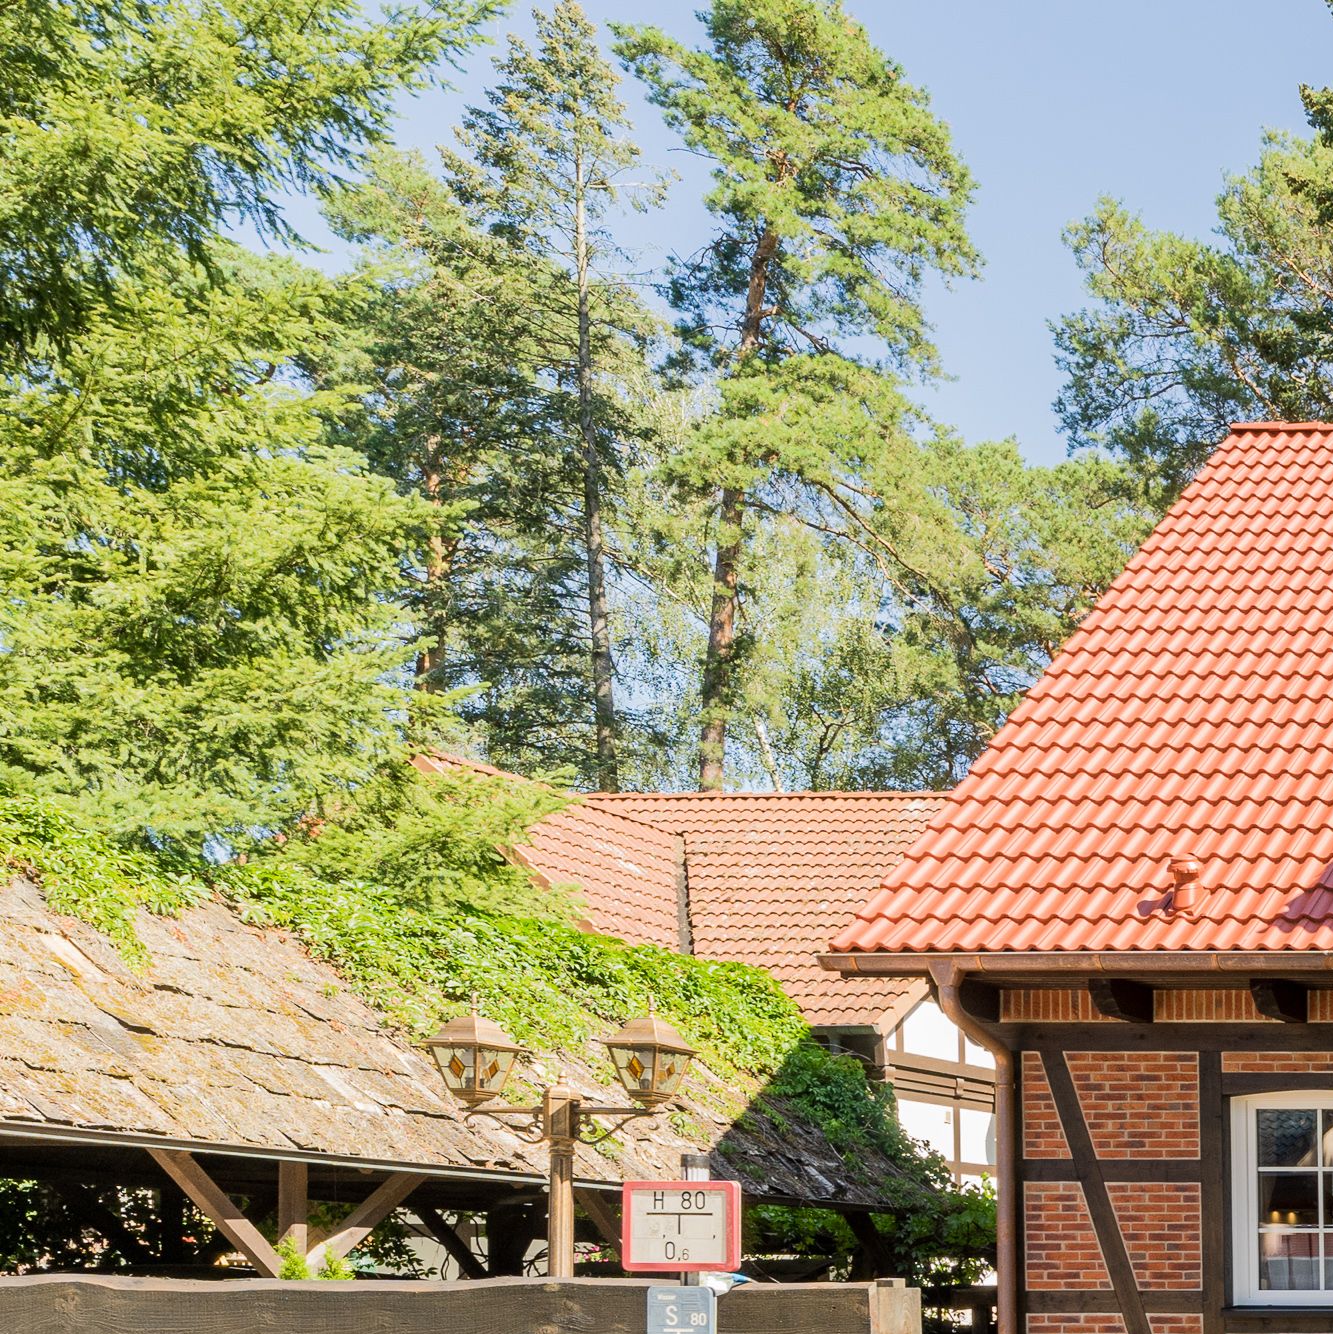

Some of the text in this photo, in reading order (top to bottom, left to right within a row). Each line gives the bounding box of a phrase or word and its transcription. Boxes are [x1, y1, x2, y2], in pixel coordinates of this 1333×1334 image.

[653, 1191, 706, 1210] H 80
[665, 1241, 690, 1261] 0,6
[665, 1305, 707, 1326] S 80
